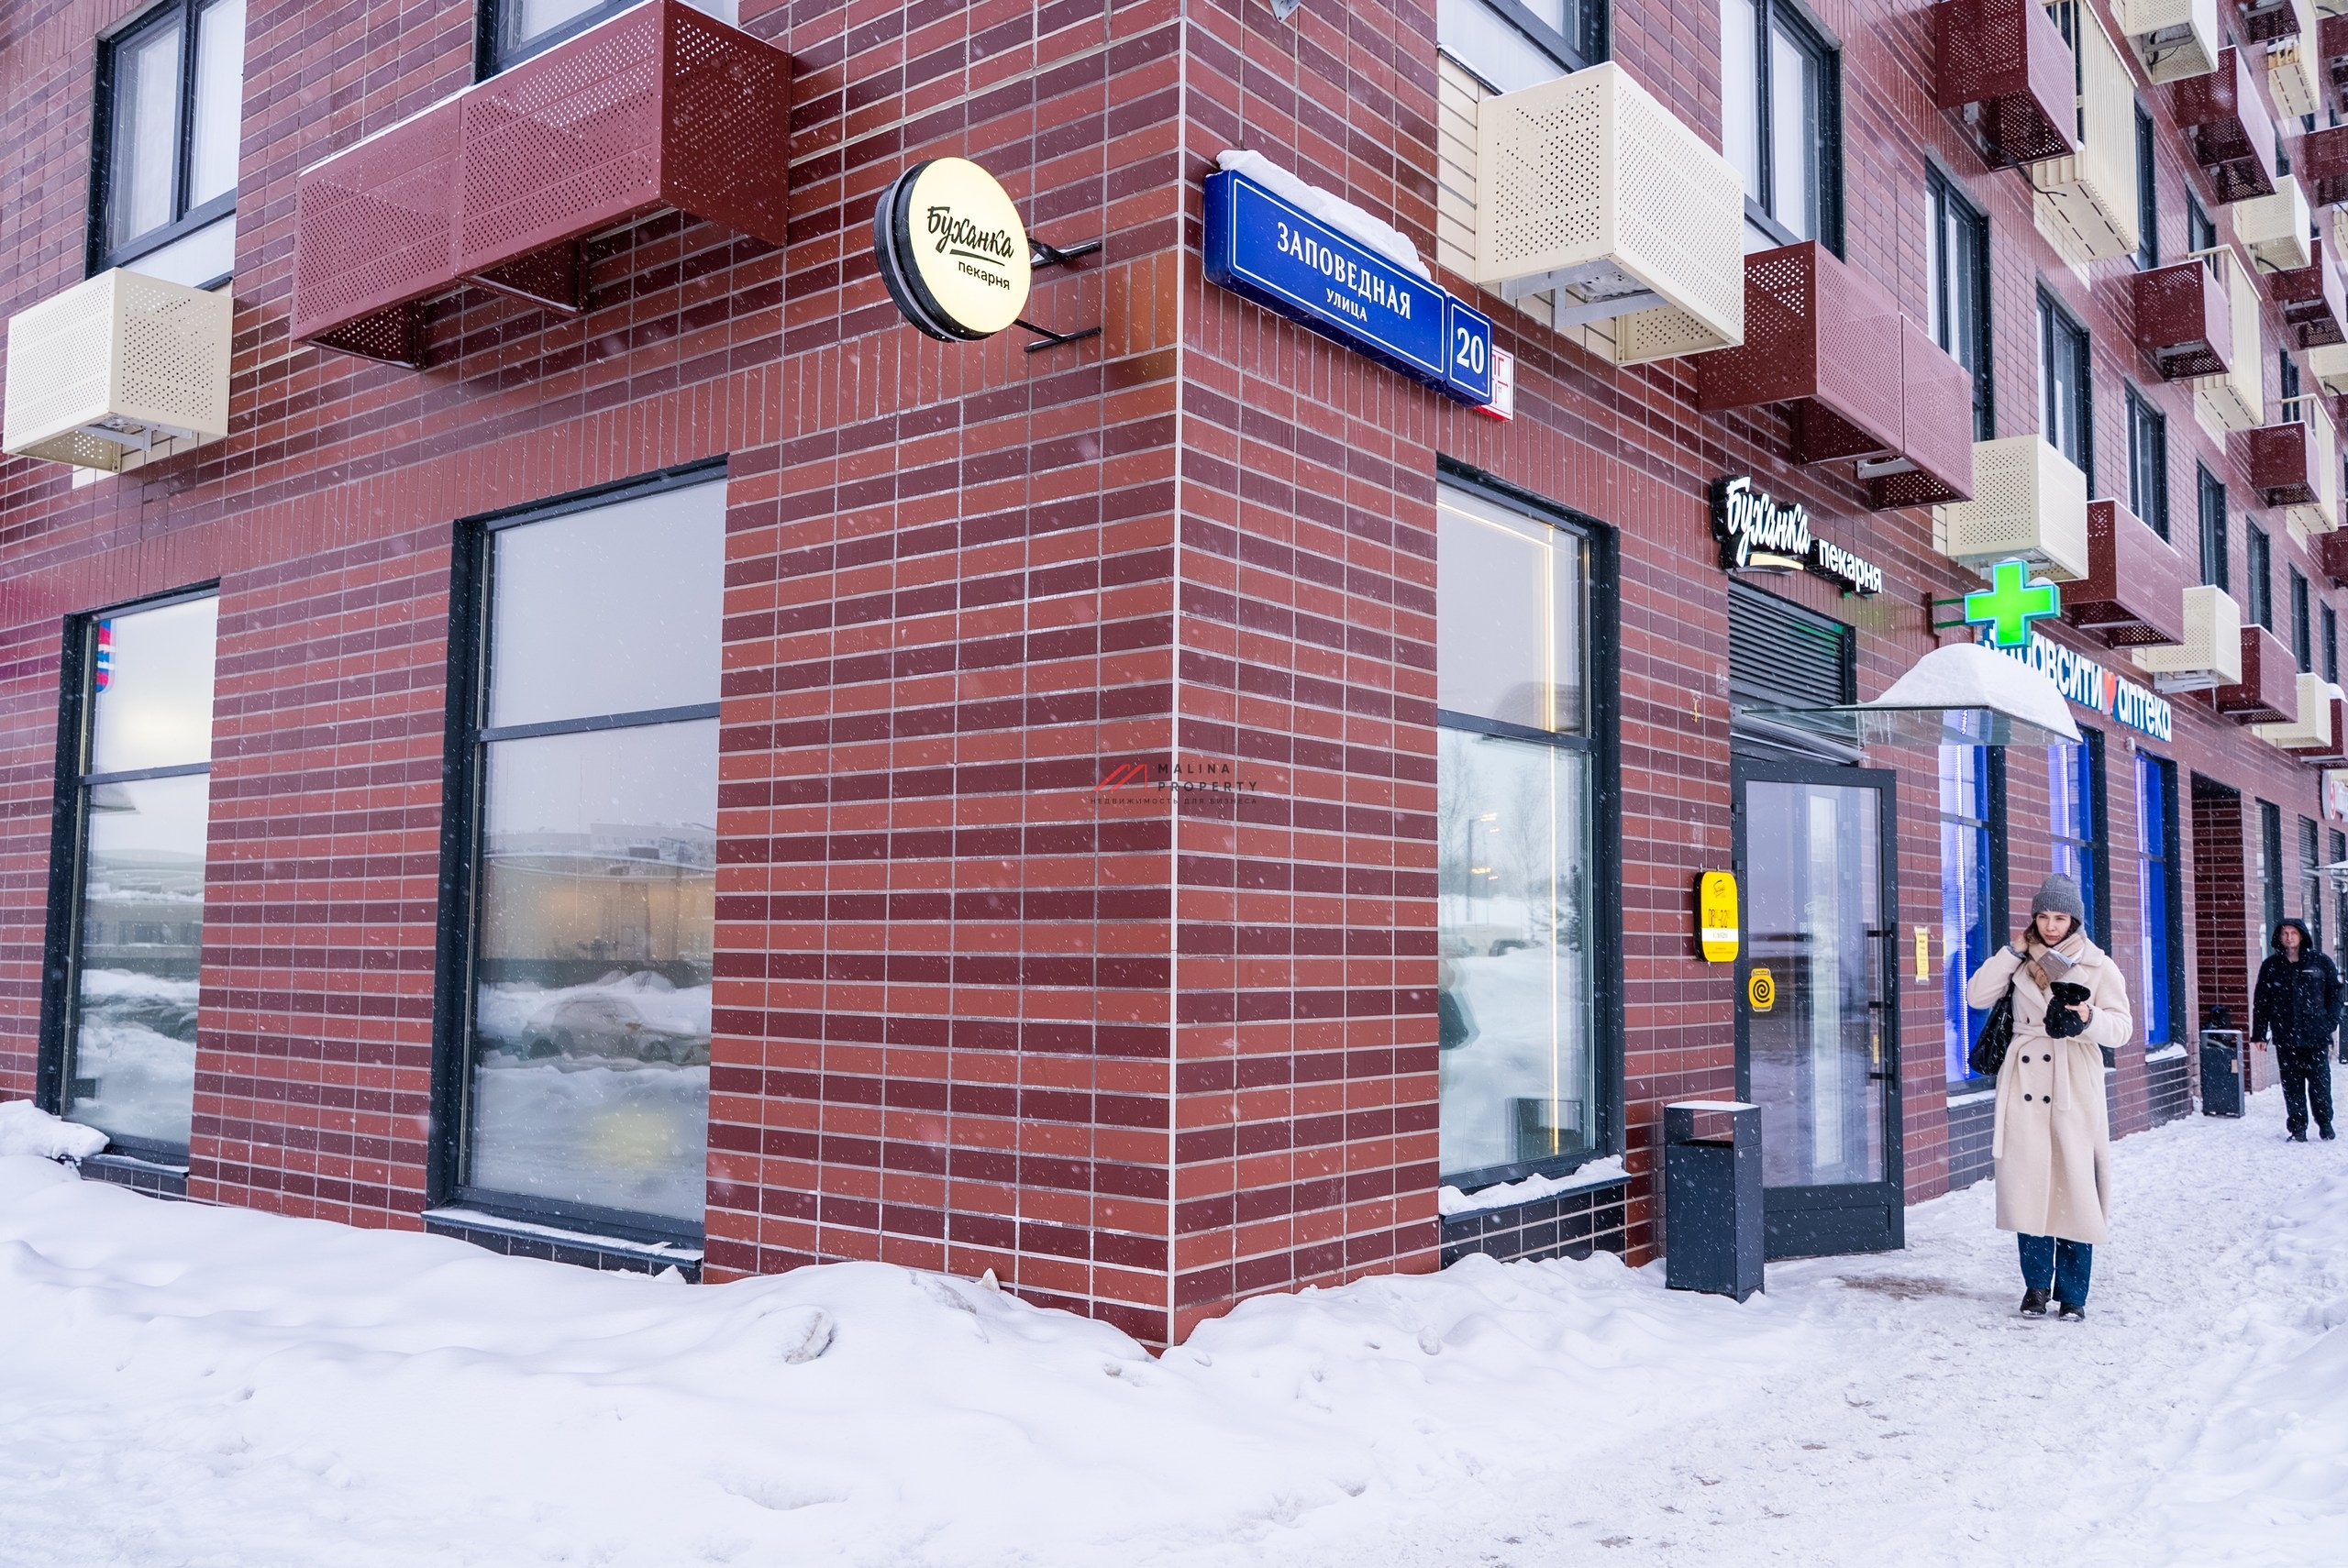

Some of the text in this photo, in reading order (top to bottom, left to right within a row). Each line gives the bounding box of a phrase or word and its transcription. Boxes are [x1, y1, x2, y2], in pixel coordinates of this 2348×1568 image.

[926, 205, 1014, 259] Буханка
[958, 260, 1010, 291] пекарня
[1277, 221, 1412, 320] ЗАПОВЕДНАЯ
[1325, 287, 1368, 323] УЛИЦА
[1456, 326, 1485, 375] 20
[1726, 476, 1883, 594] Буханка пекарня
[1985, 627, 2172, 743] авсити аптека
